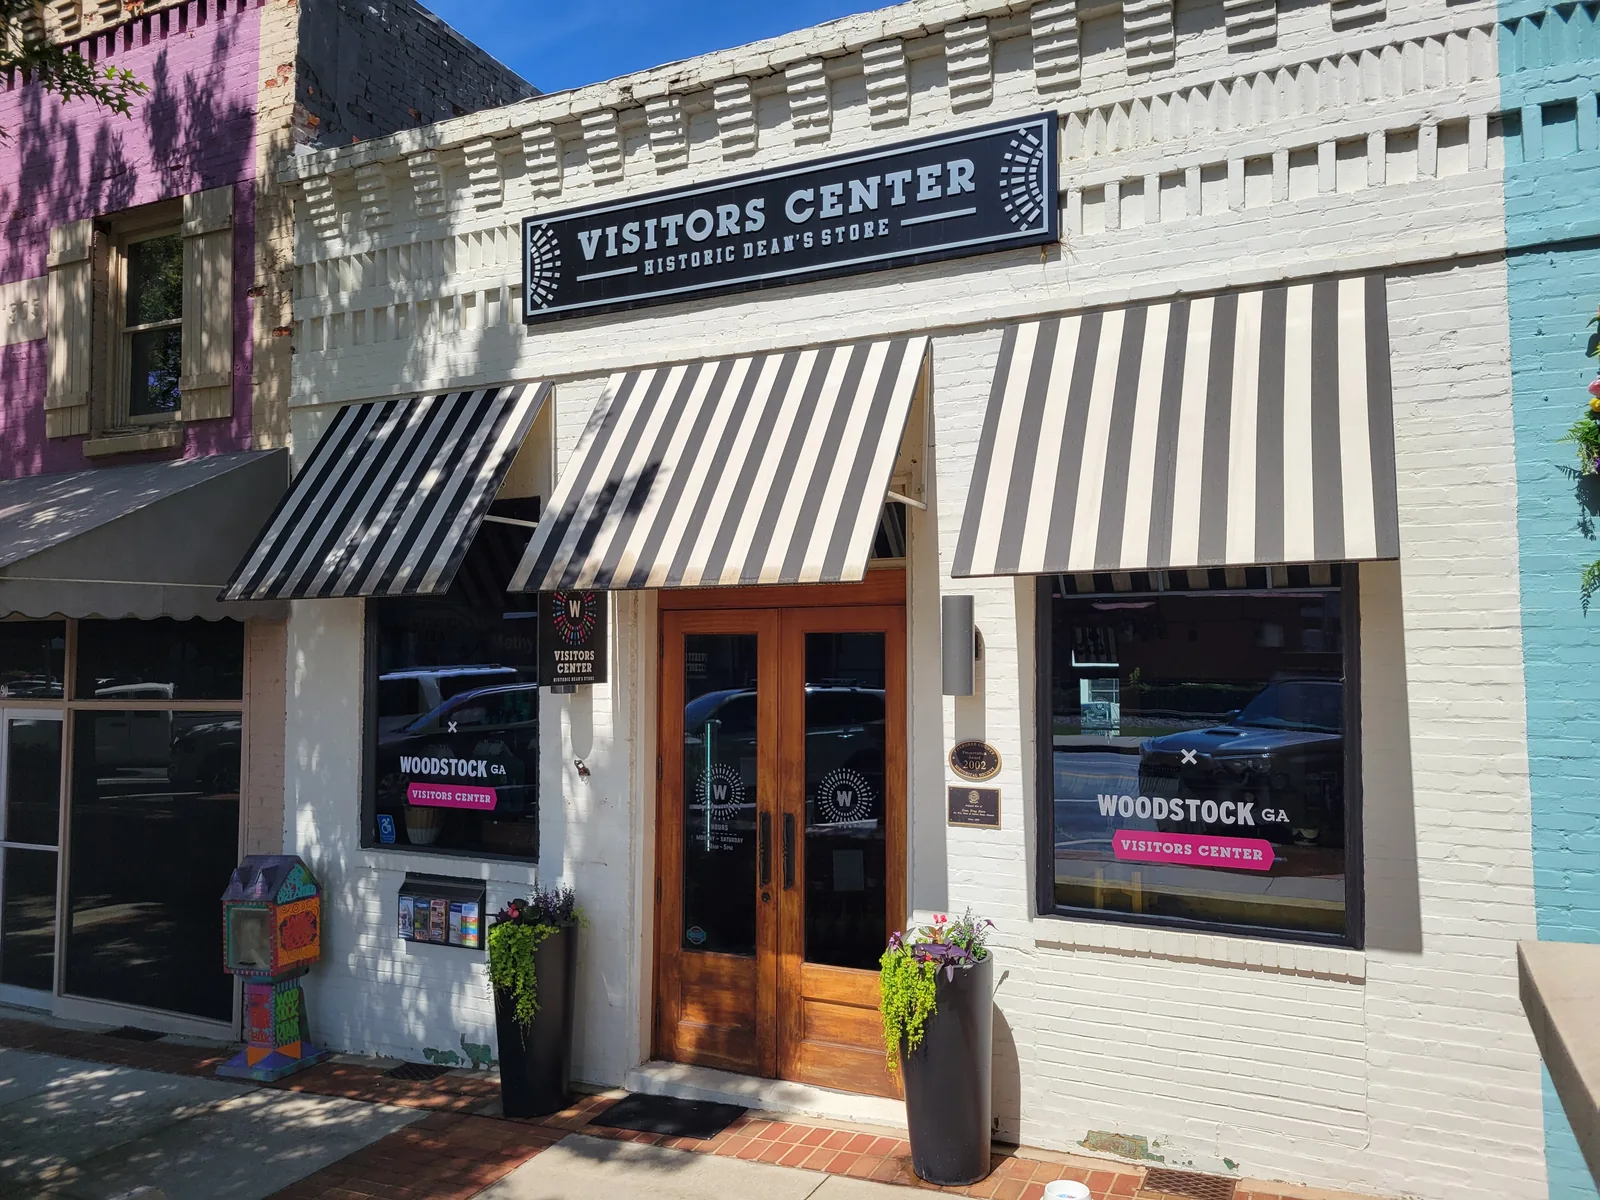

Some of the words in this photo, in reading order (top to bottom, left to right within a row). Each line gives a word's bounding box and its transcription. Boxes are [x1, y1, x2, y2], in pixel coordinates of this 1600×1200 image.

[577, 197, 766, 261] VISITORS
[784, 158, 976, 224] CENTER
[644, 245, 735, 276] HISTORIC
[743, 232, 814, 260] DEAN'S
[822, 218, 889, 246] STORE
[568, 599, 581, 618] W
[554, 650, 595, 661] VISITORS
[557, 662, 592, 673] CENTER
[400, 756, 488, 778] WOODSTOCK
[490, 765, 507, 775] GA
[963, 760, 987, 770] 2002
[412, 789, 452, 801] VISITORS
[455, 792, 491, 803] CENTER
[713, 785, 727, 800] W
[837, 790, 853, 807] W
[1097, 794, 1255, 826] WOODSTOCK
[1261, 808, 1290, 823] GA
[1121, 839, 1193, 855] VISITORS
[1198, 845, 1263, 861] CENTER
